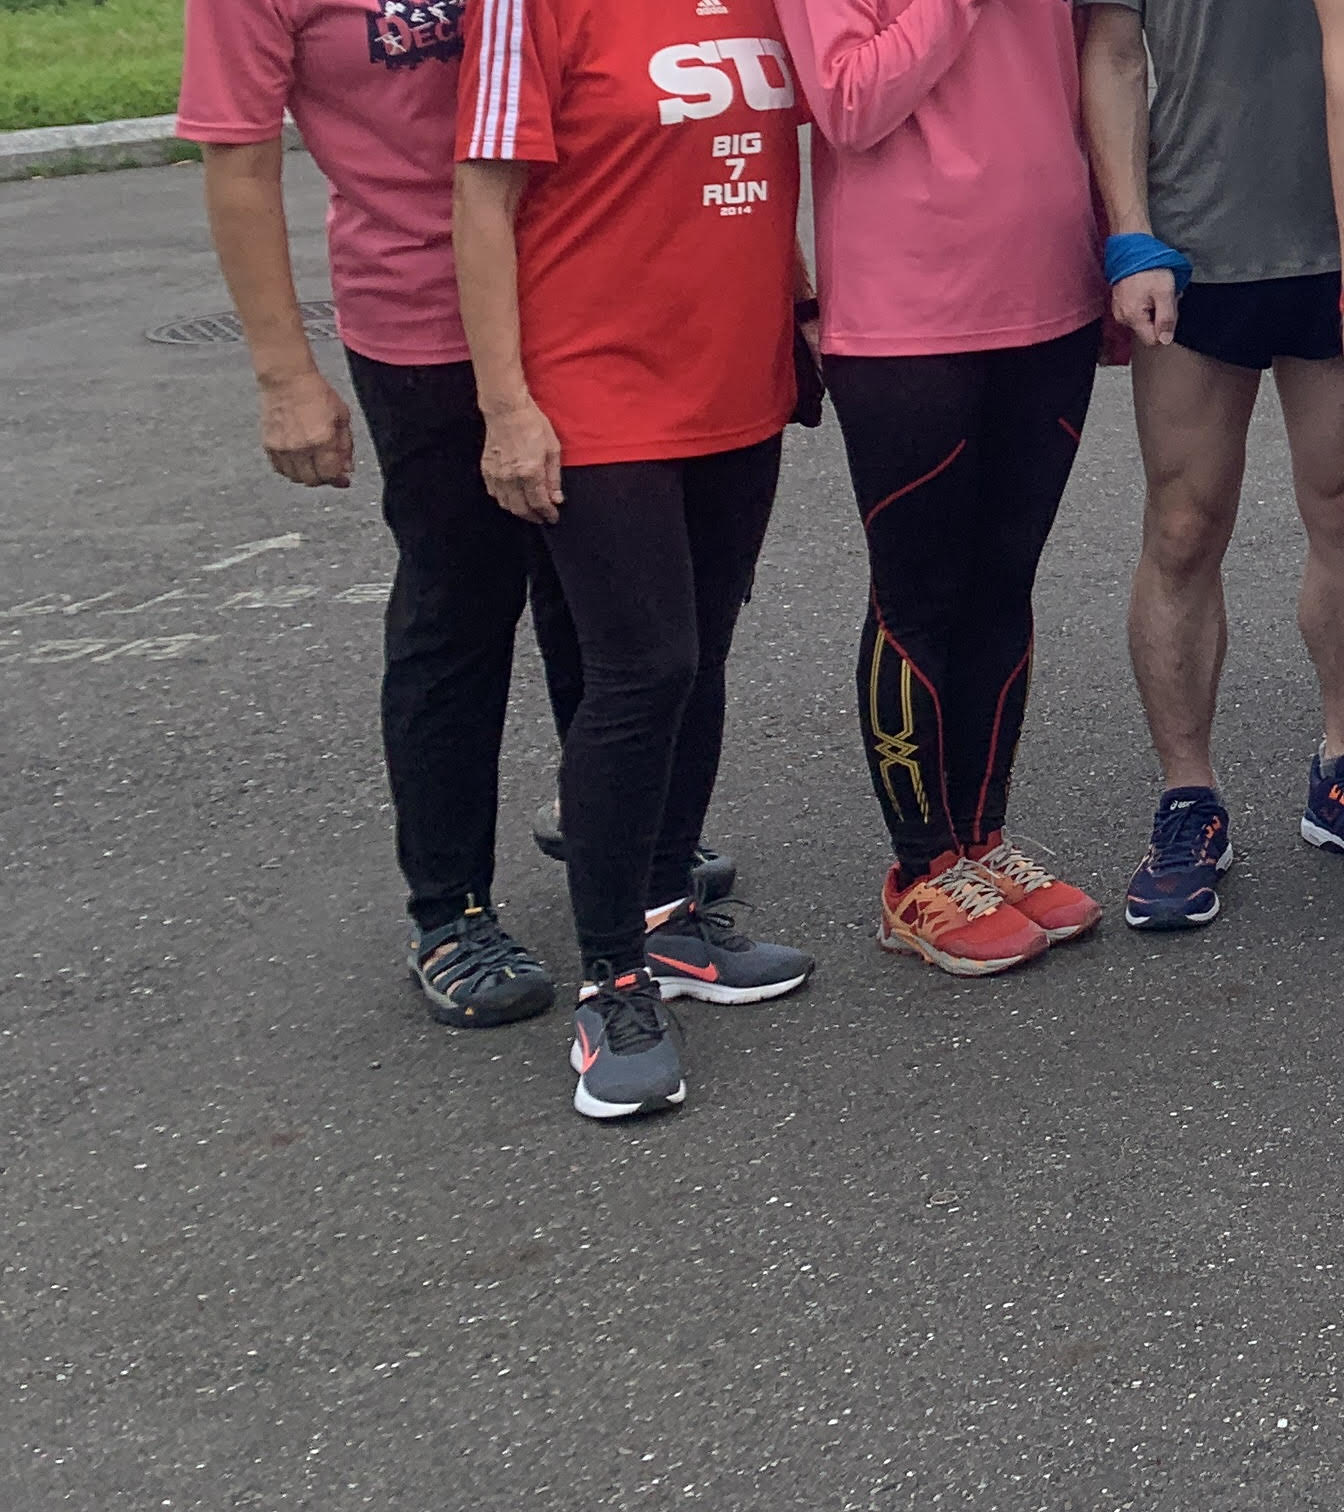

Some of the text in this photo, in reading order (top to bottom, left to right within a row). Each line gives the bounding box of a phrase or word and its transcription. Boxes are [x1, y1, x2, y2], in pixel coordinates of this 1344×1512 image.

[712, 132, 762, 157] BIG
[725, 157, 746, 181] 7
[703, 180, 767, 206] RUN
[720, 206, 752, 216] 2014
